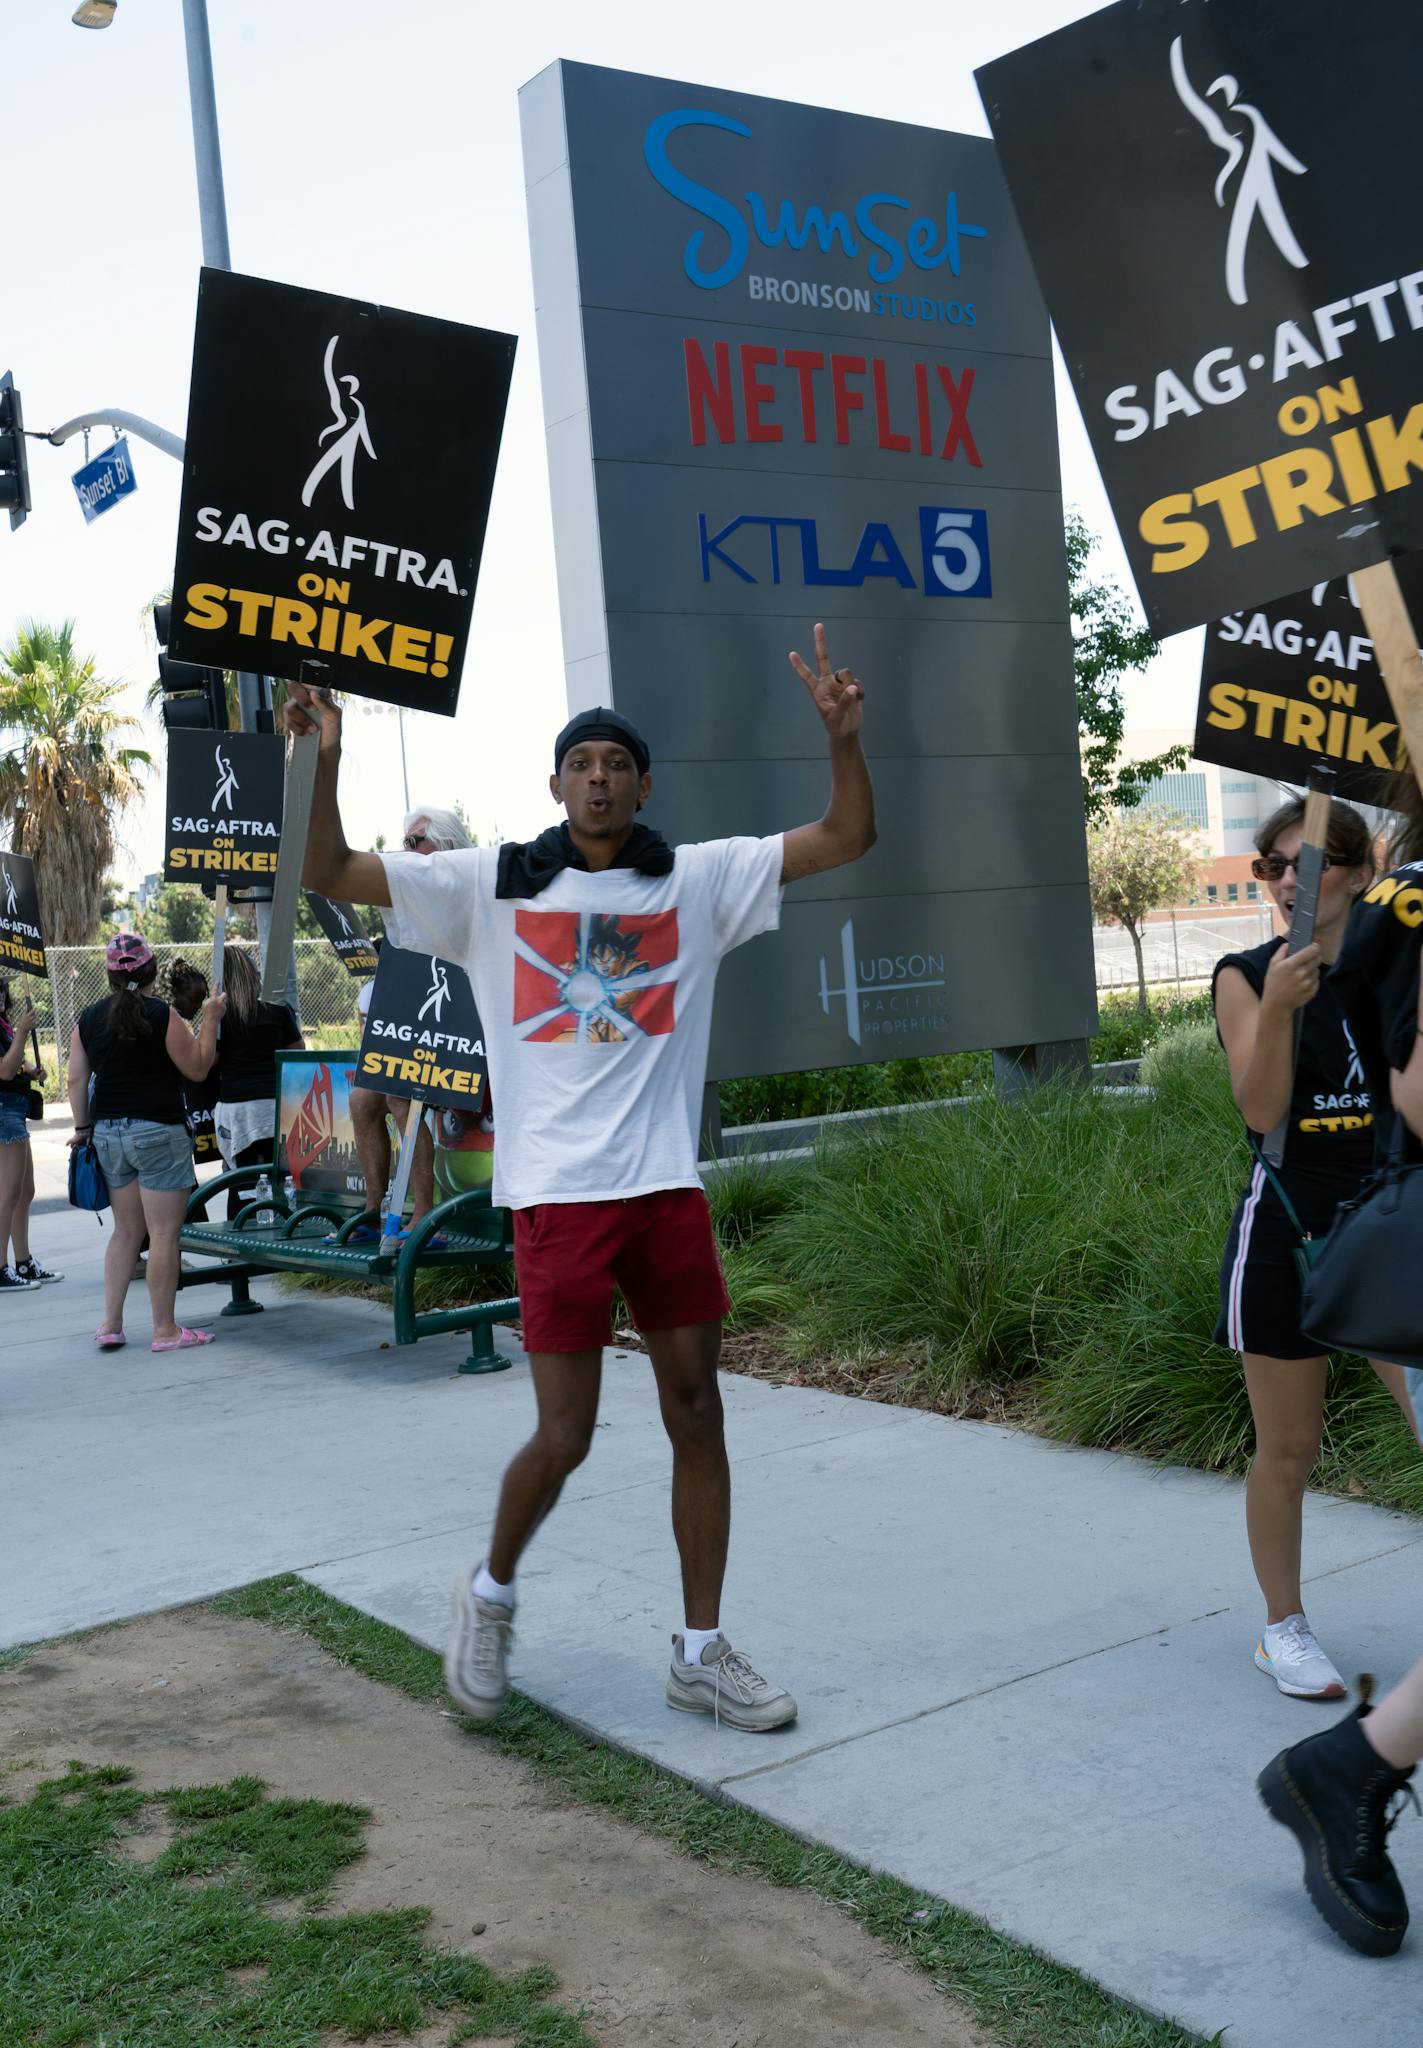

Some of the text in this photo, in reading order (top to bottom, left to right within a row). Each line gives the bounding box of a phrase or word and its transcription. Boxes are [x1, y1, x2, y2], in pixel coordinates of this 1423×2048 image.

[749, 275, 977, 327] BRONSON STUDIOS
[684, 338, 983, 468] NETFLIX
[1278, 376, 1364, 437] ON
[80, 455, 129, 509] Sunset Bl
[697, 512, 982, 592] KTLA 5
[297, 572, 350, 605] ON
[184, 582, 454, 678] STRIKE!
[1307, 674, 1358, 708] ON
[169, 847, 278, 873] STRIKE!
[213, 837, 235, 849] ON
[12, 934, 23, 944] ON
[362, 1052, 481, 1095] STRIKE!
[413, 1048, 437, 1064] ON
